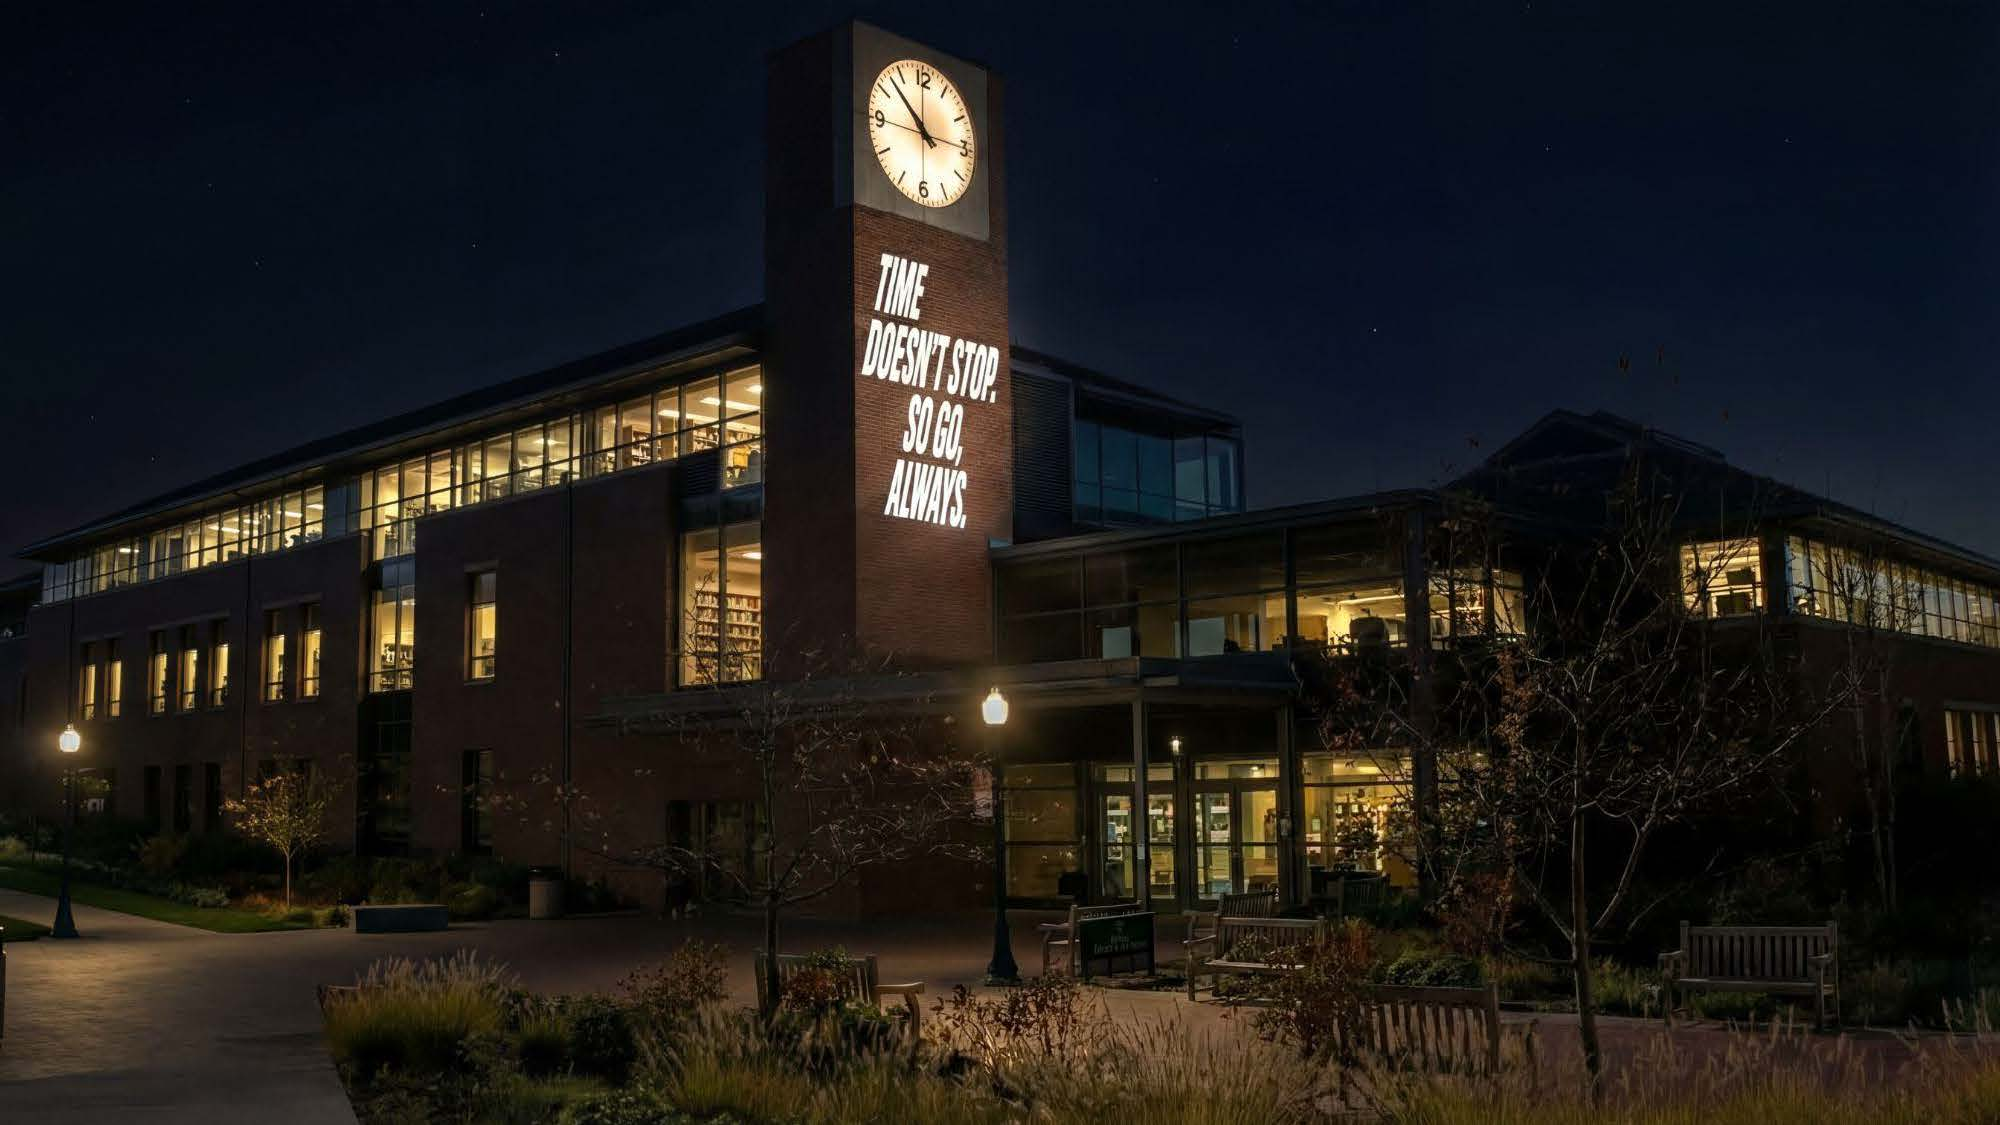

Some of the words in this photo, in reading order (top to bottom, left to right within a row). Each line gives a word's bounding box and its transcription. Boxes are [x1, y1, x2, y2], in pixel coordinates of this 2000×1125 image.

[916, 69, 931, 90] 12
[874, 110, 885, 128] 9
[959, 139, 968, 157] 3
[918, 181, 929, 198] 6
[874, 253, 929, 320] TIME
[861, 319, 950, 391] DOESN'T
[947, 339, 999, 403] STOP.
[903, 394, 934, 454] SO
[933, 401, 964, 466] GO,
[884, 459, 967, 529] ALWAYS.
